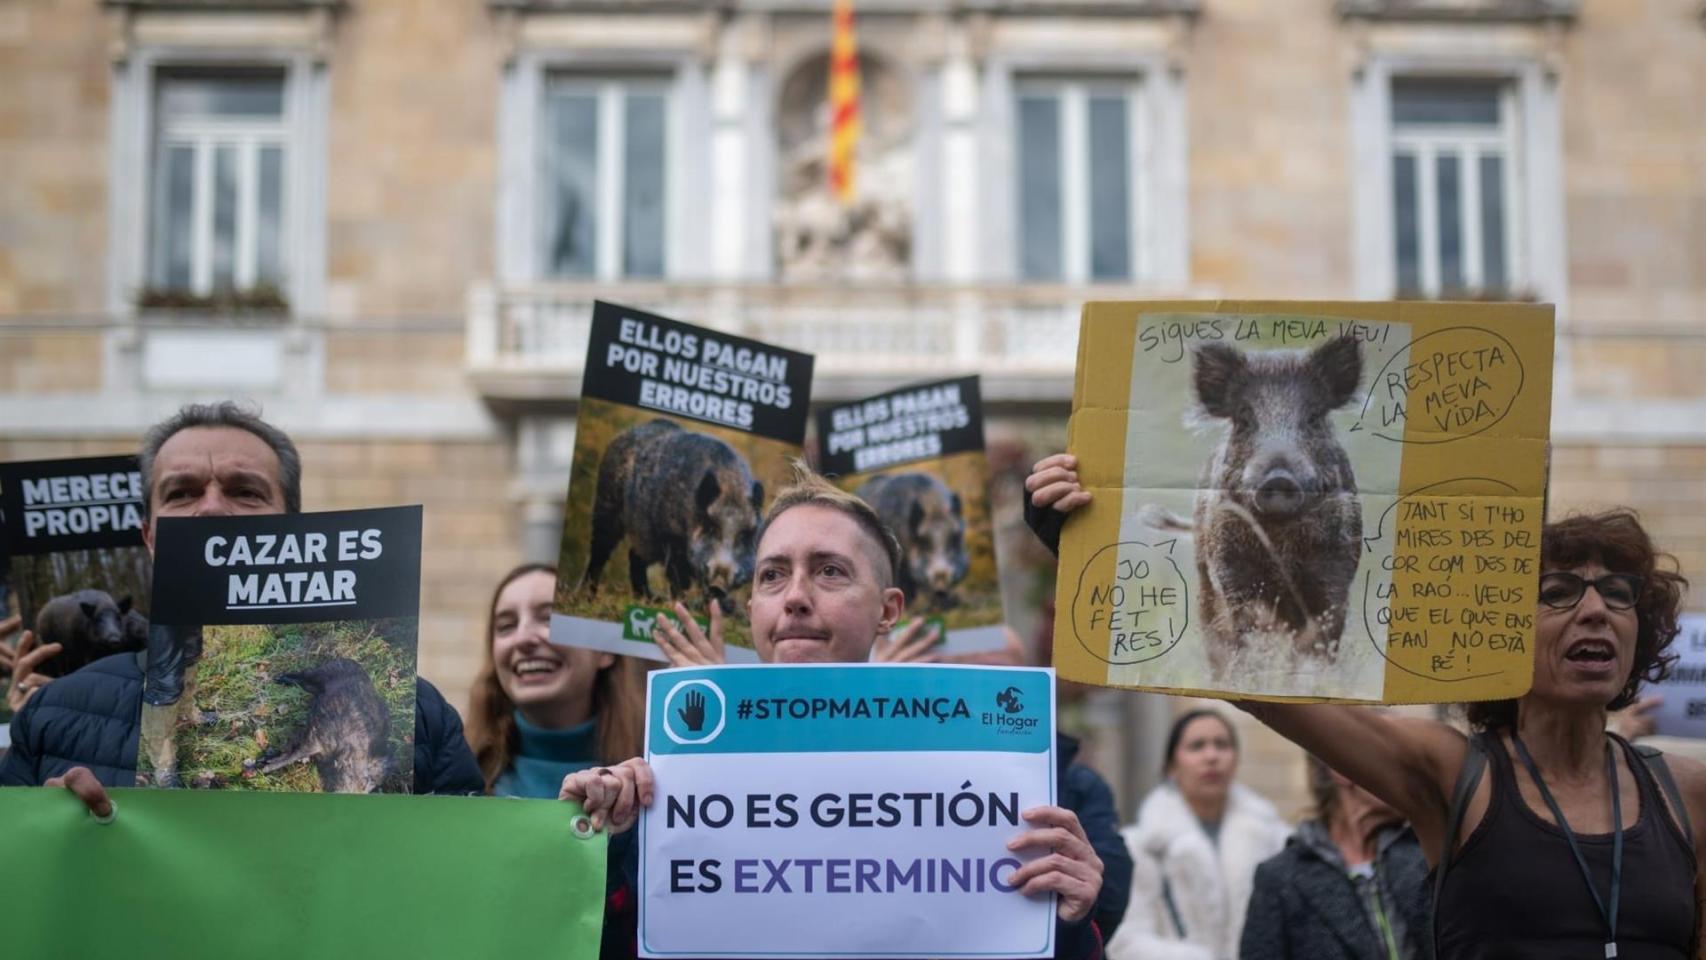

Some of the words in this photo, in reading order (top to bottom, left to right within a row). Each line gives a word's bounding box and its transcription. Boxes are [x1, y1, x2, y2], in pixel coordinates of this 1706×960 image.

[619, 319, 698, 358] ELLOS
[702, 340, 788, 380] PAGAN
[1235, 320, 1260, 341] LA
[1273, 320, 1328, 344] MEVA
[1339, 321, 1389, 352] VEU!
[607, 343, 657, 376] POR
[663, 360, 791, 408] NUESTROS
[1387, 347, 1505, 398] RESPECTA
[640, 382, 753, 427] ERRORES
[832, 402, 889, 431] ELLOS
[892, 384, 959, 418] PAGAN
[1382, 400, 1408, 427] LA
[1426, 378, 1492, 417] MEVA
[828, 430, 863, 455] POR
[867, 409, 968, 444] NUESTROS
[854, 436, 941, 471] ERRORES
[1402, 501, 1449, 521] TANT
[1485, 506, 1524, 525] T'HO
[205, 533, 327, 566] CAZAR
[338, 529, 383, 560] ES
[1462, 530, 1495, 548] DES
[1503, 530, 1537, 549] DEL
[1117, 560, 1150, 580] JO
[1382, 555, 1420, 573] COR
[1429, 555, 1464, 573] COM
[1475, 555, 1506, 573] DES
[1514, 558, 1533, 575] DE
[228, 570, 356, 605] MATAR
[1091, 584, 1124, 607] NO
[1140, 586, 1177, 607] HE
[1377, 584, 1398, 599] LA
[1475, 584, 1523, 606] VEUS
[1090, 609, 1150, 631] FET
[1377, 606, 1420, 628] QUE
[1430, 608, 1454, 625] EL
[1461, 609, 1498, 629] QUE
[1506, 613, 1533, 630] ENS
[1114, 617, 1174, 656] RES!
[1388, 629, 1428, 648] FAN
[1452, 630, 1483, 649] NO
[737, 696, 970, 724] #STOPMATANÇA
[982, 713, 992, 725] El
[997, 714, 1038, 730] Hogar
[667, 794, 734, 828] NO
[747, 794, 799, 828] ES
[810, 780, 1019, 828] GESTIÓN
[670, 859, 721, 893] ES
[734, 858, 1023, 894] EXTERMINIO
